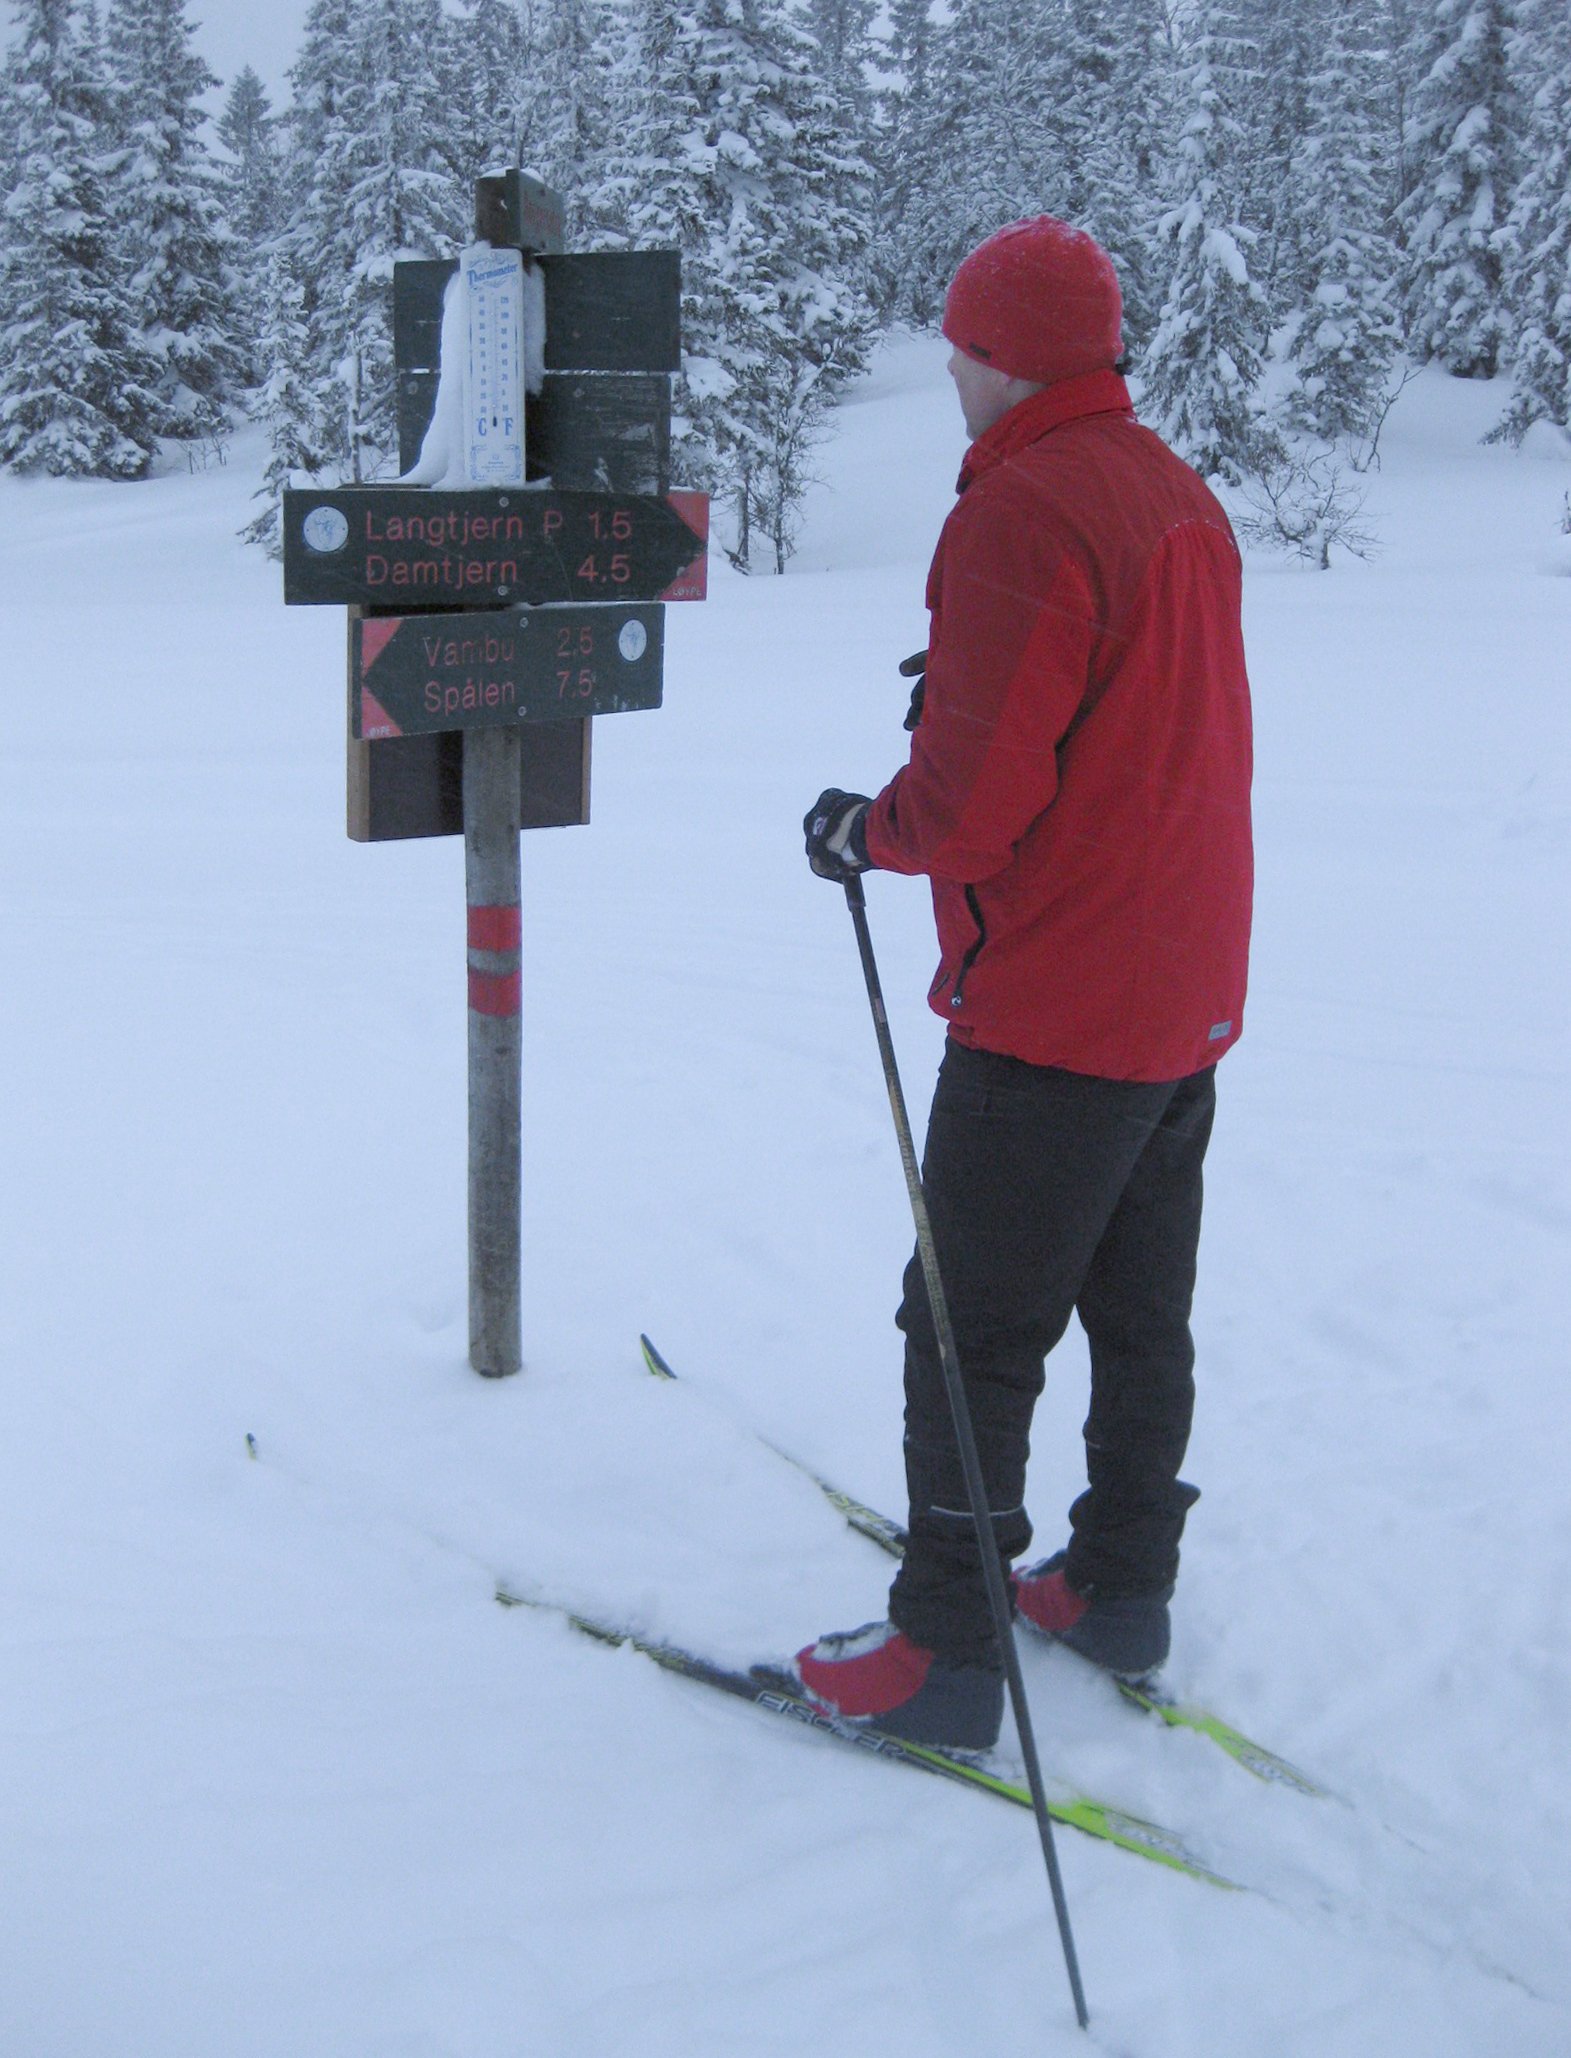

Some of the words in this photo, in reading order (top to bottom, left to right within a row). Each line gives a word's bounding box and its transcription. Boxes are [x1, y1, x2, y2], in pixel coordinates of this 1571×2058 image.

[466, 263, 518, 286] Thermometer
[365, 510, 524, 546] Langtjern
[543, 510, 563, 536] P
[365, 554, 518, 588] Damtjern
[421, 634, 516, 668] Vambu
[424, 678, 516, 716] Spålen
[755, 1689, 906, 1757] FISCER
